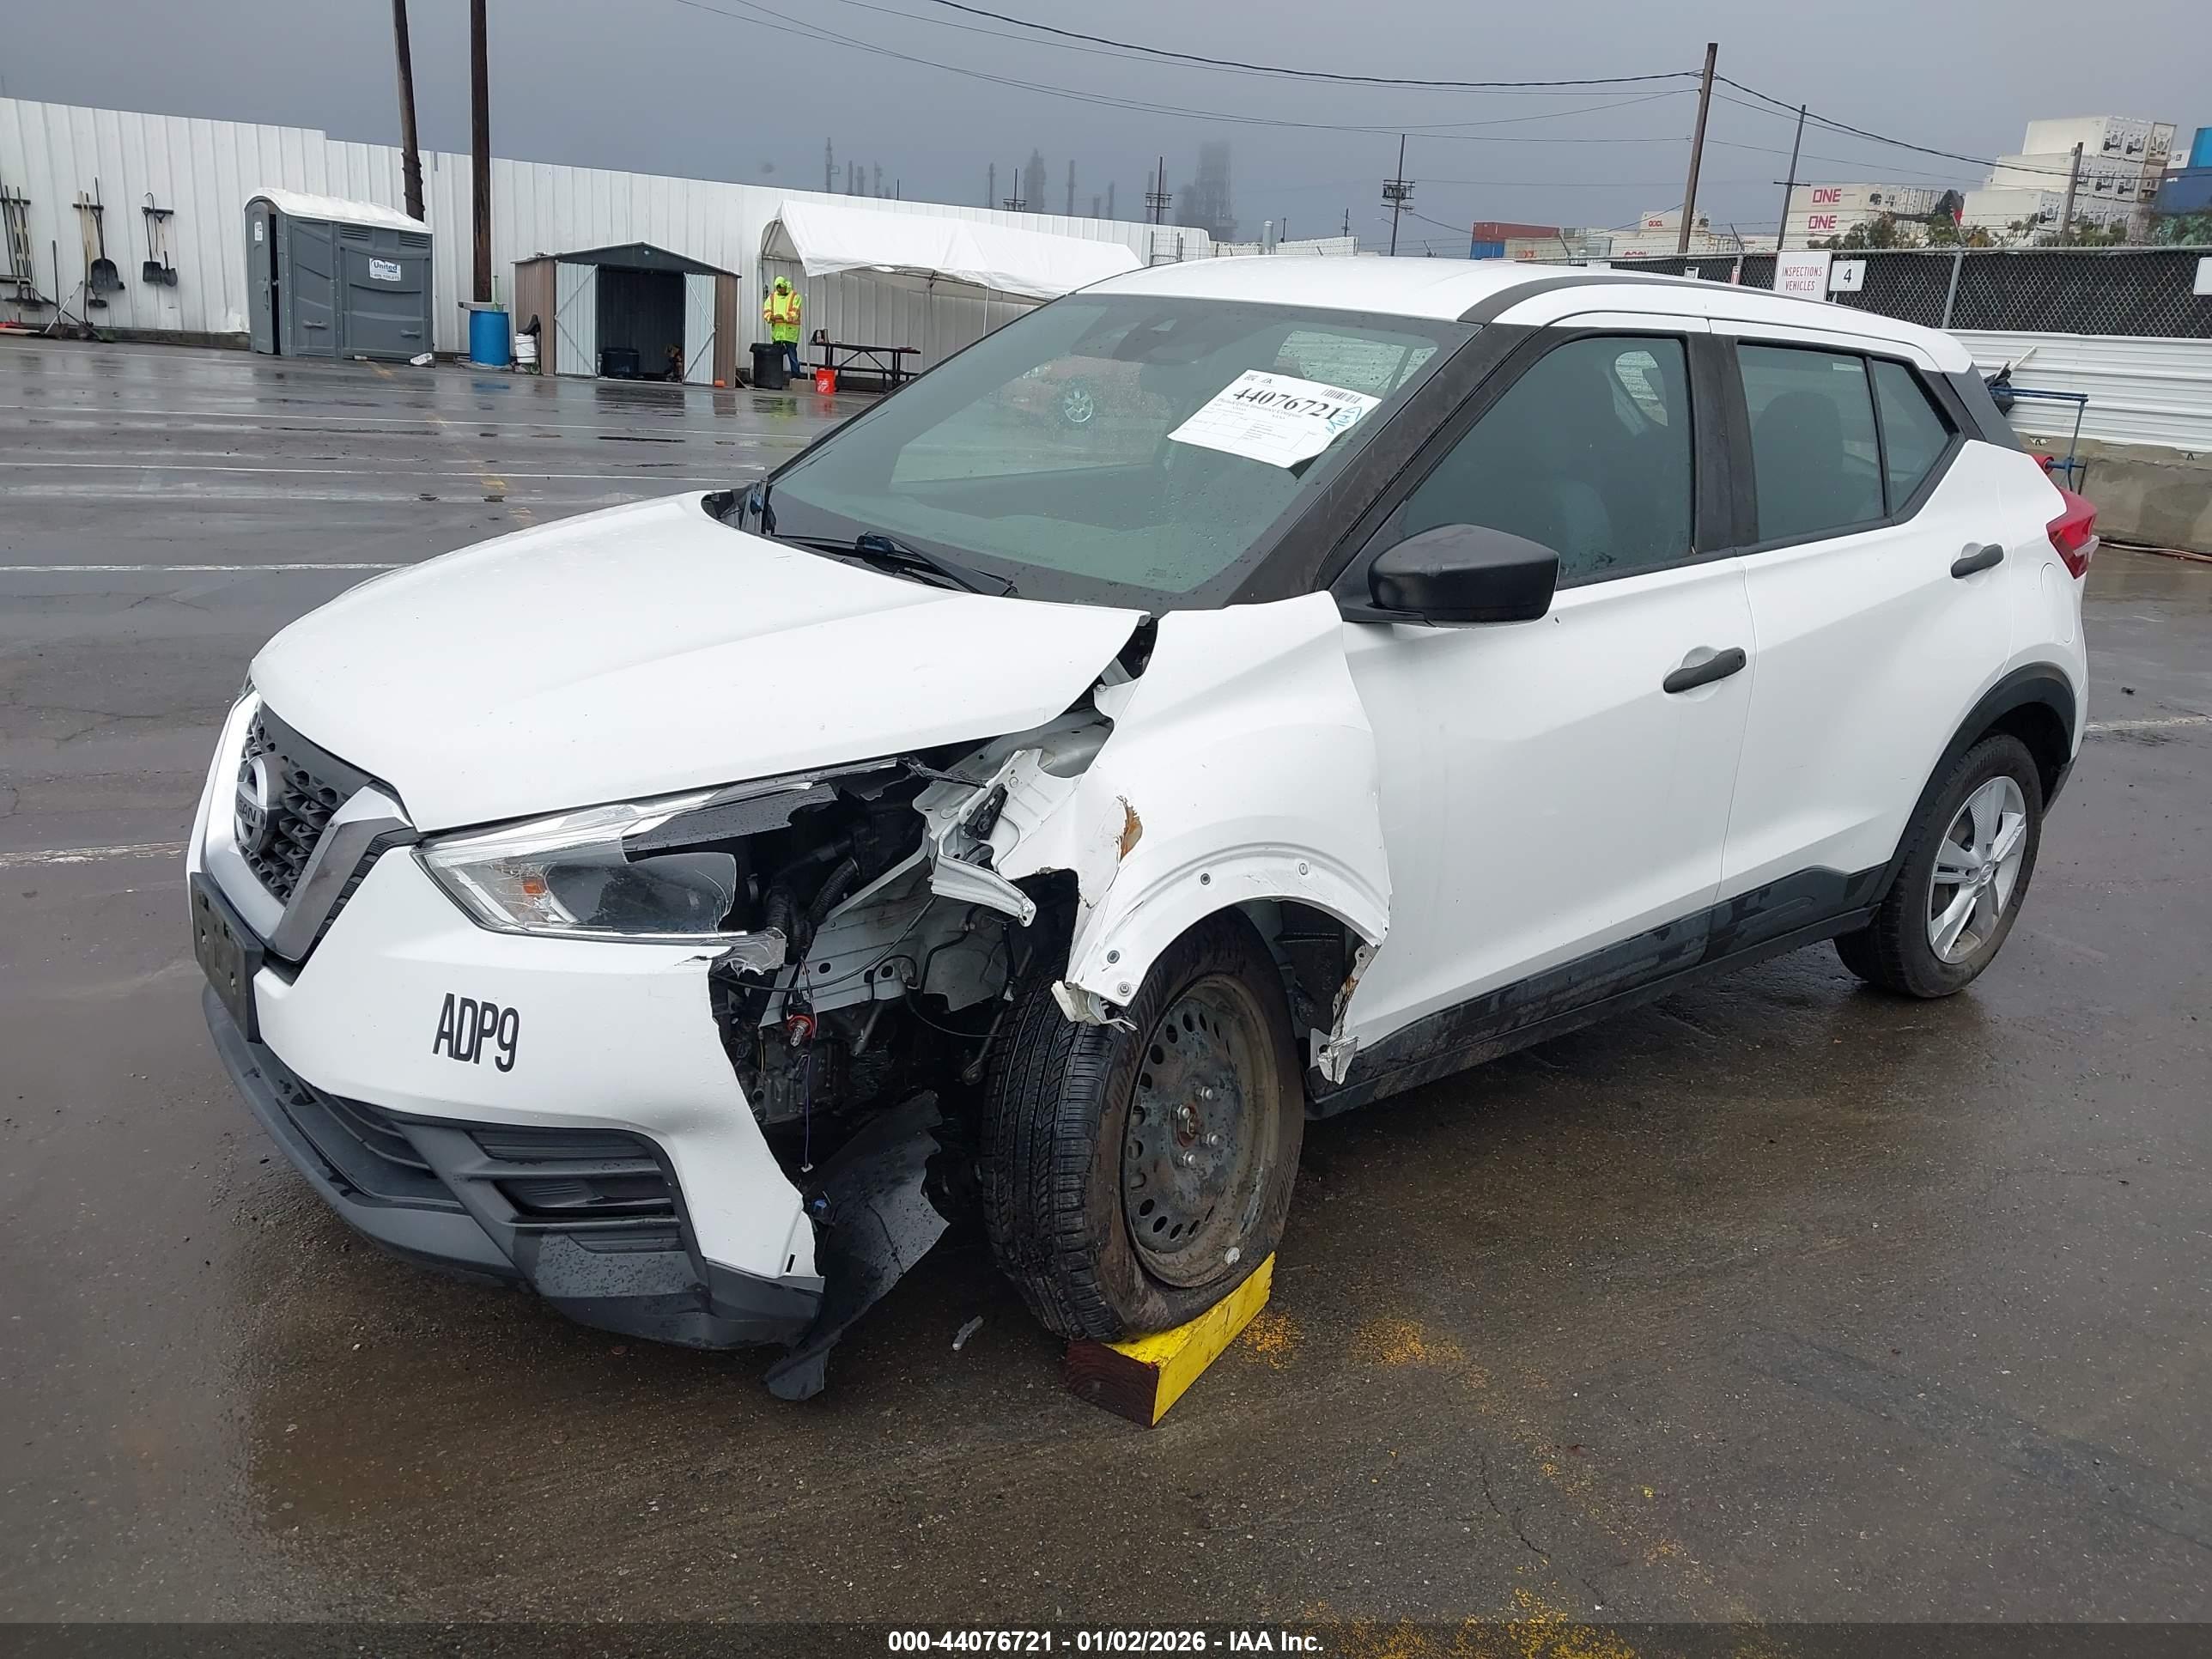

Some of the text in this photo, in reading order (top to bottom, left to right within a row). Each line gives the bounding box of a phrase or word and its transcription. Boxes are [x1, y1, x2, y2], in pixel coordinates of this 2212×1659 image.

[1812, 188, 1841, 203] ONE
[1808, 215, 1837, 229] ONE
[1781, 266, 1823, 277] INSPECTIONS
[1843, 268, 1852, 283] 4
[1785, 279, 1816, 291] VEHICLES
[1233, 387, 1343, 420] 44076721
[432, 992, 520, 1073] ADP9
